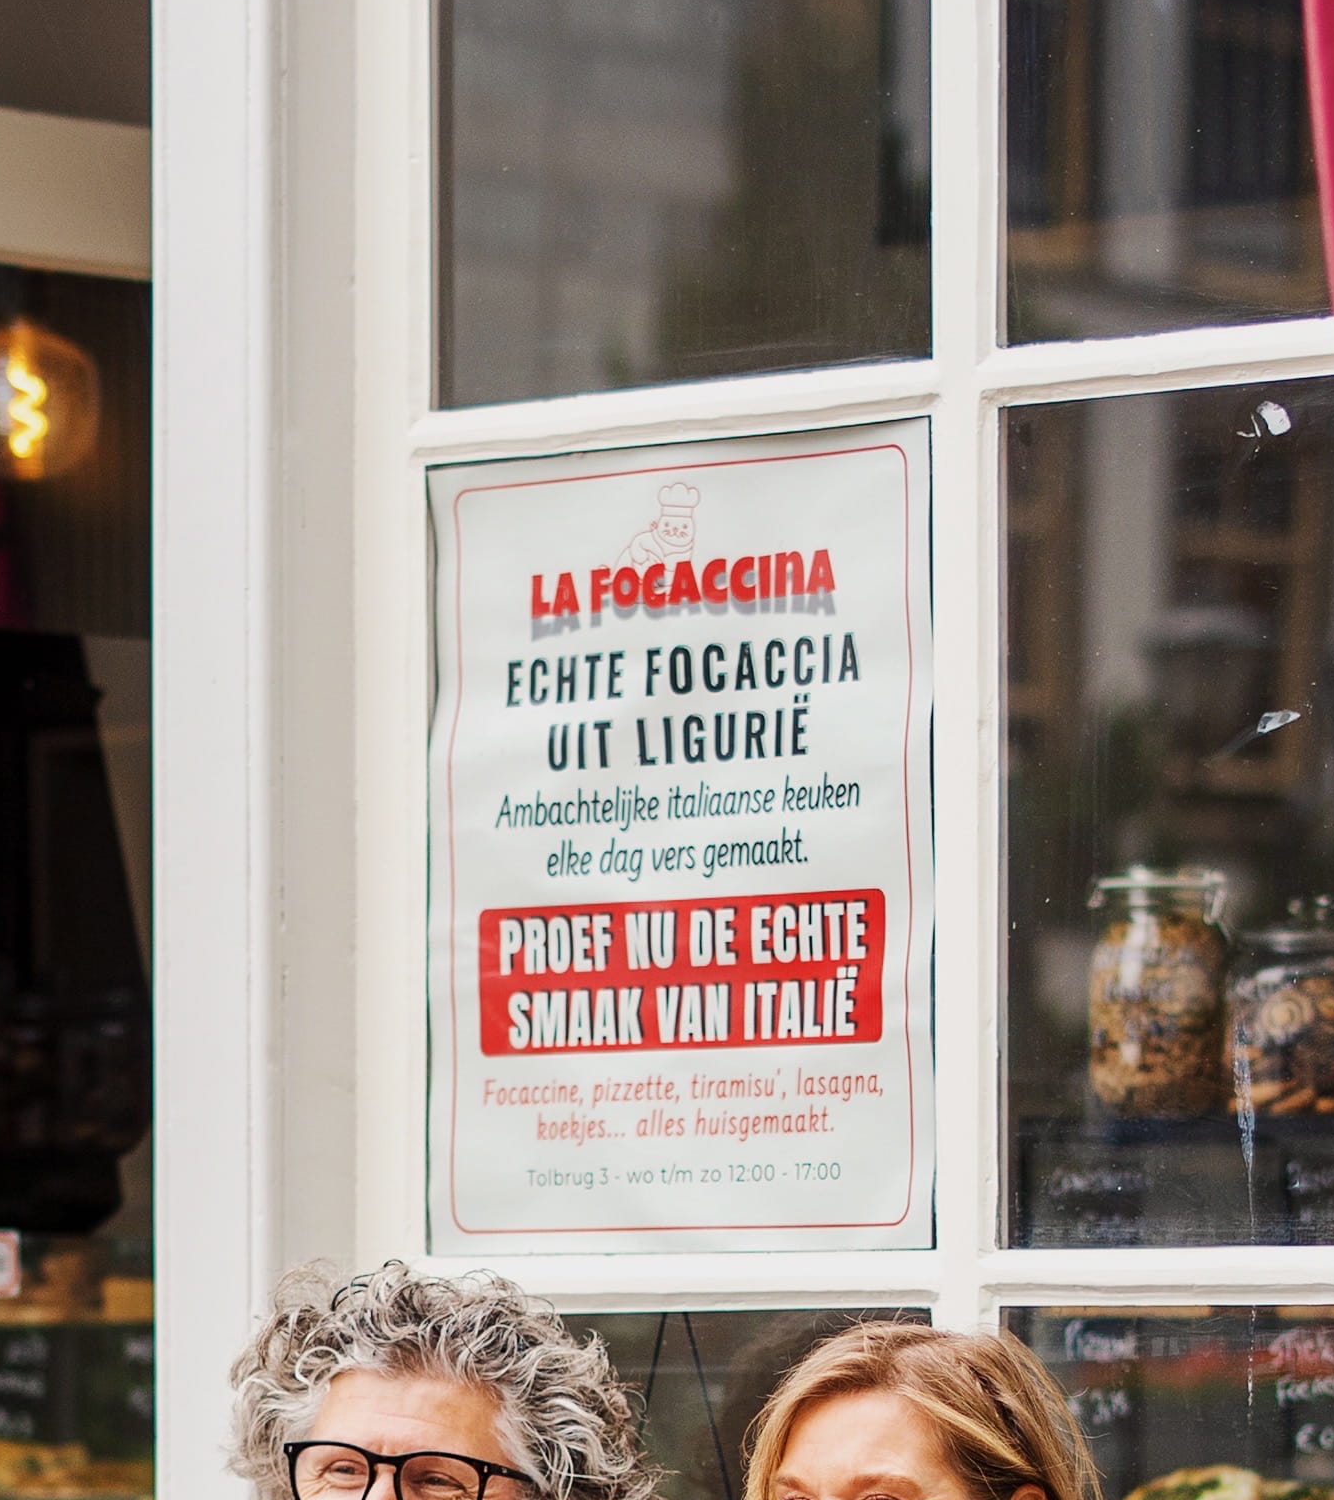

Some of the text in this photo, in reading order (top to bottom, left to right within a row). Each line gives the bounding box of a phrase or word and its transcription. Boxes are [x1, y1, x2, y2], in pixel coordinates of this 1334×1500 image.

[531, 572, 581, 621] LA
[506, 632, 861, 708] ECHTE FOCACCIA
[548, 692, 810, 772] UIT LIGURIË
[495, 771, 861, 832] Ambachtelijke italiaanse keuken
[546, 826, 809, 882] elke dag vers gemaakt.
[499, 901, 868, 977] PROEF NU DE ECHTE
[507, 965, 859, 1050] SMAAK VAN ITALIË
[483, 1077, 584, 1108] Focaccine,
[592, 1073, 681, 1109] pizzette,
[795, 1066, 885, 1103] lasagna,
[536, 1104, 835, 1147] koekjes... alles huisgemaakt.
[527, 1166, 594, 1190] Tolbrug
[598, 1167, 609, 1185] 3
[627, 1168, 654, 1185] wo
[661, 1163, 693, 1184] t/m
[700, 1167, 722, 1184] zo
[729, 1163, 776, 1183] 12:00
[794, 1161, 842, 1182] 17:00
